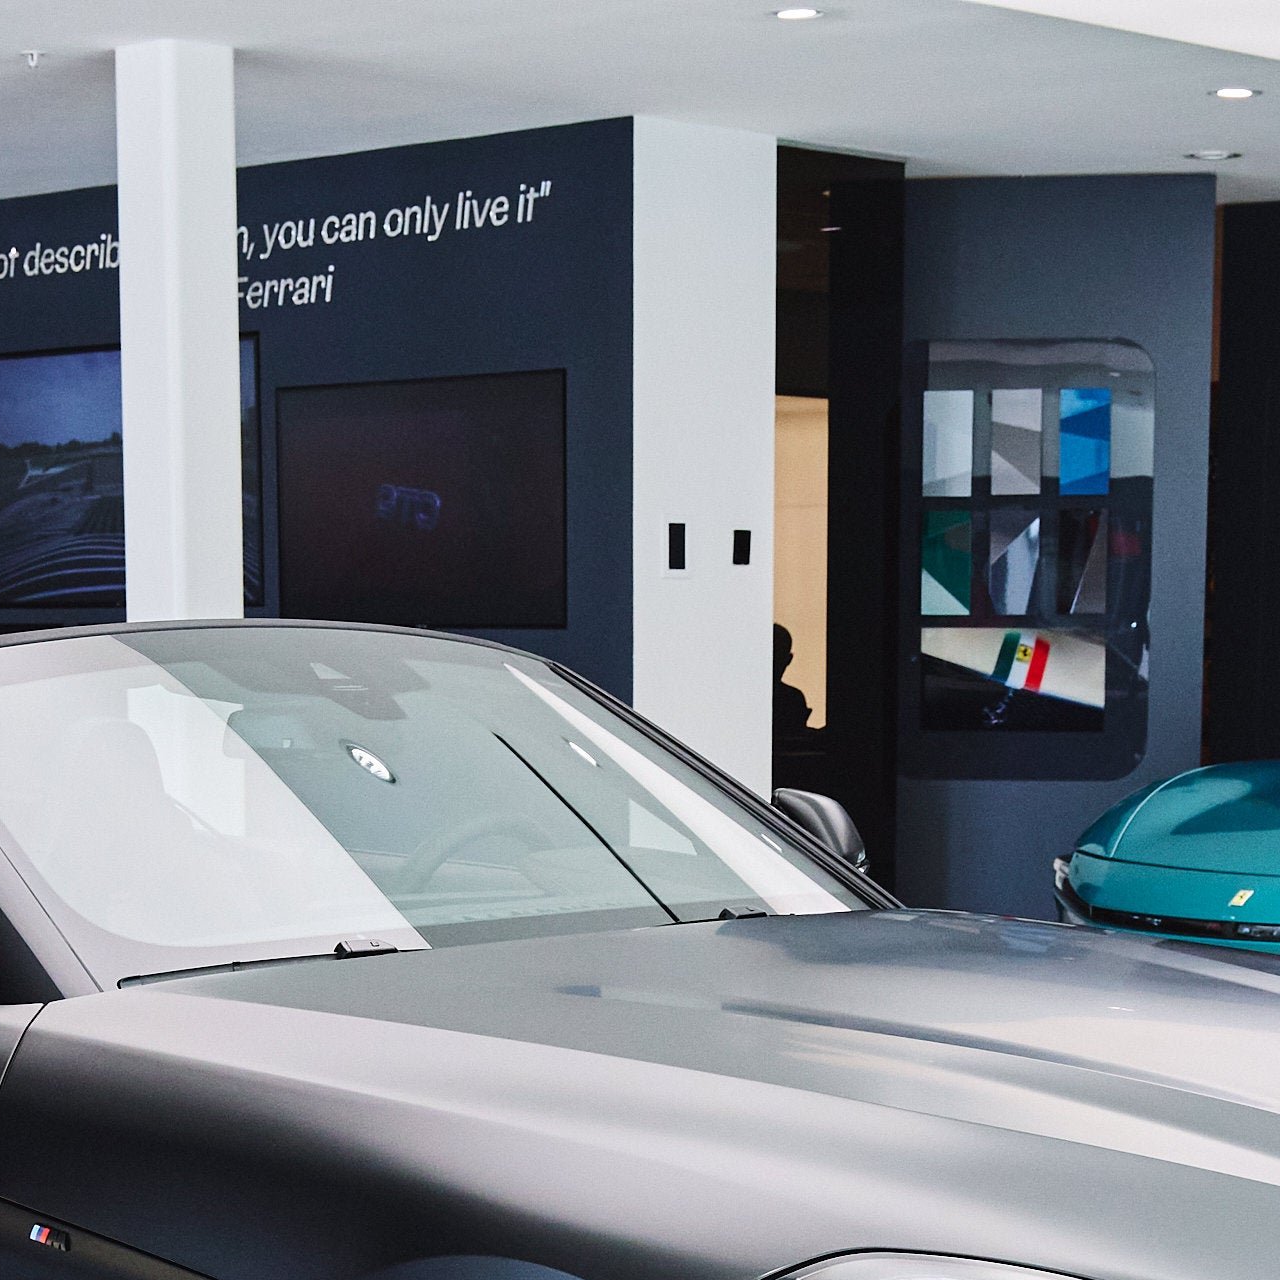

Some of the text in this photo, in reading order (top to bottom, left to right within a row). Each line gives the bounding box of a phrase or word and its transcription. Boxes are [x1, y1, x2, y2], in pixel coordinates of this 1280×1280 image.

[23, 232, 120, 278] describ
[259, 217, 315, 260] you
[321, 210, 376, 244] can
[383, 195, 450, 242] only
[455, 190, 509, 230] live
